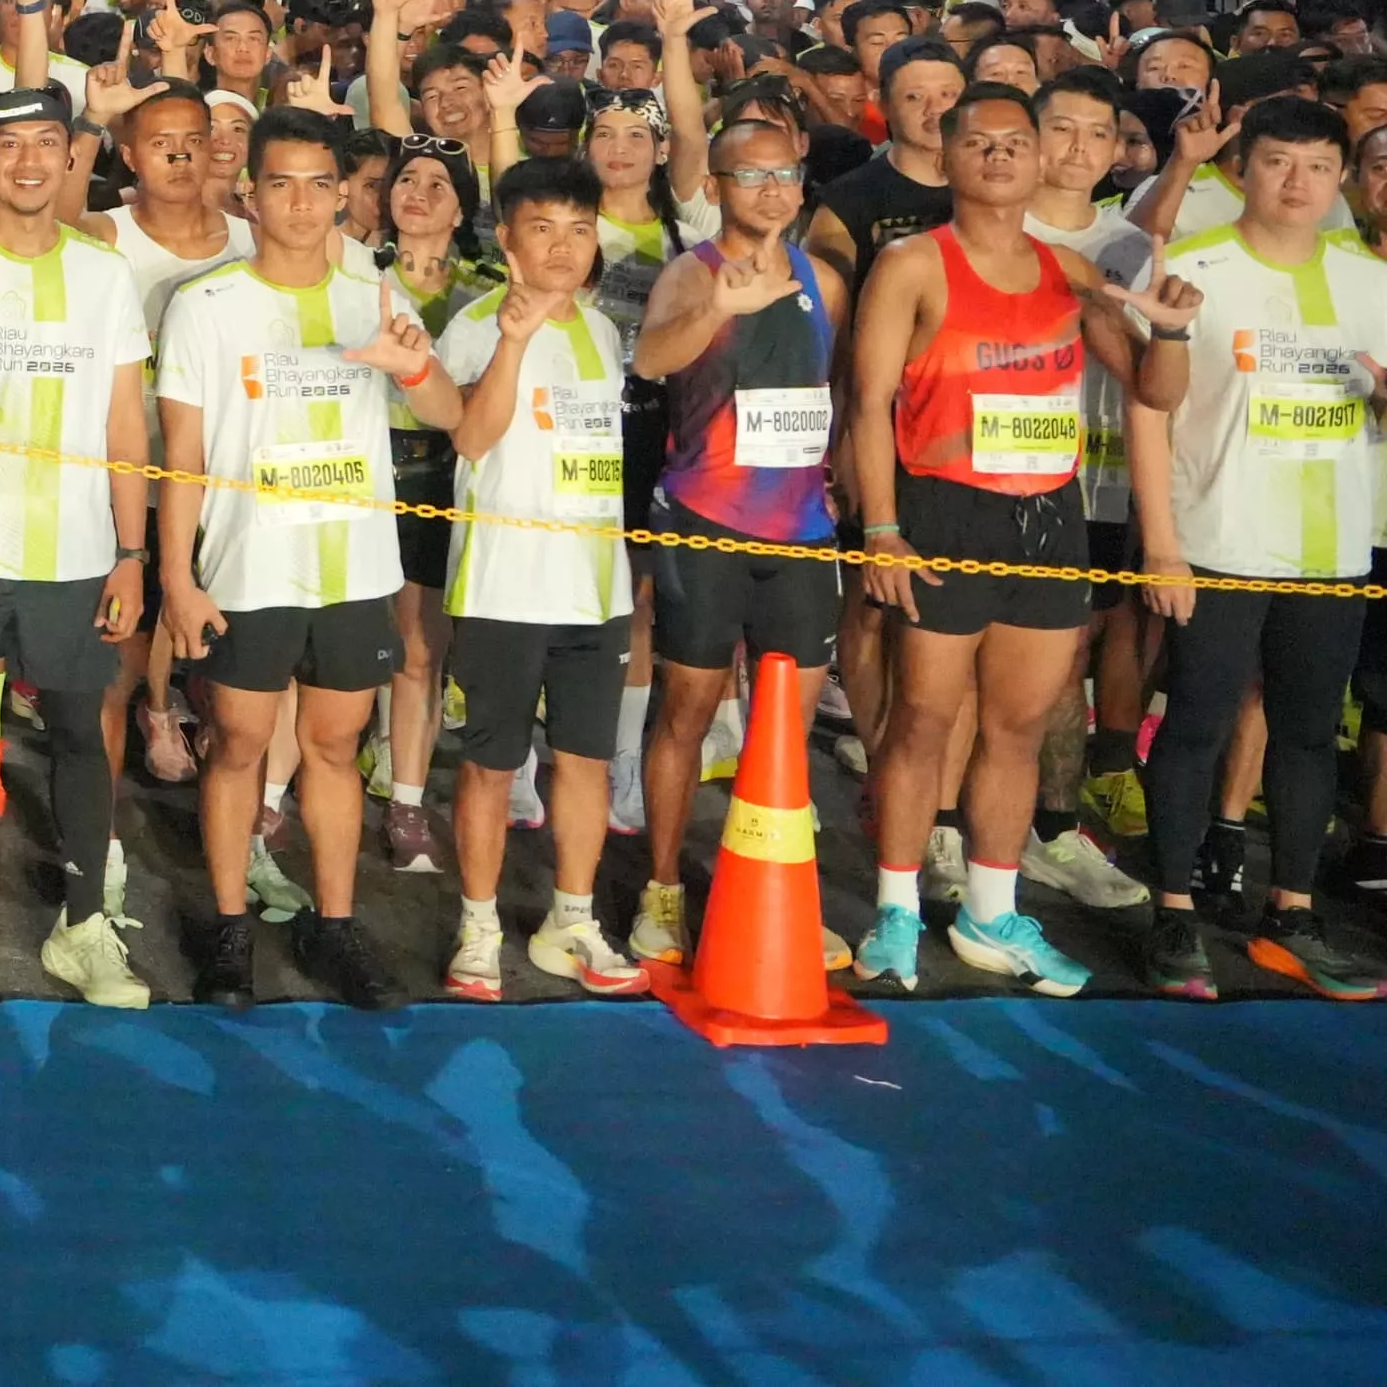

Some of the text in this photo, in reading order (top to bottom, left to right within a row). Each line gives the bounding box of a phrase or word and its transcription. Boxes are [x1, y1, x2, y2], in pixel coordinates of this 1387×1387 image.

[1259, 328, 1298, 344] Riau
[26, 361, 76, 373] 2026
[264, 352, 299, 367] Riau
[1260, 356, 1350, 375] Run 2026
[265, 366, 373, 384] Bhayangkara
[267, 383, 351, 398] Run 2026
[1260, 402, 1356, 427] M-8021917
[980, 415, 1077, 440] M-8022048
[260, 460, 366, 490] M-8020405
[561, 458, 624, 482] M-80215
